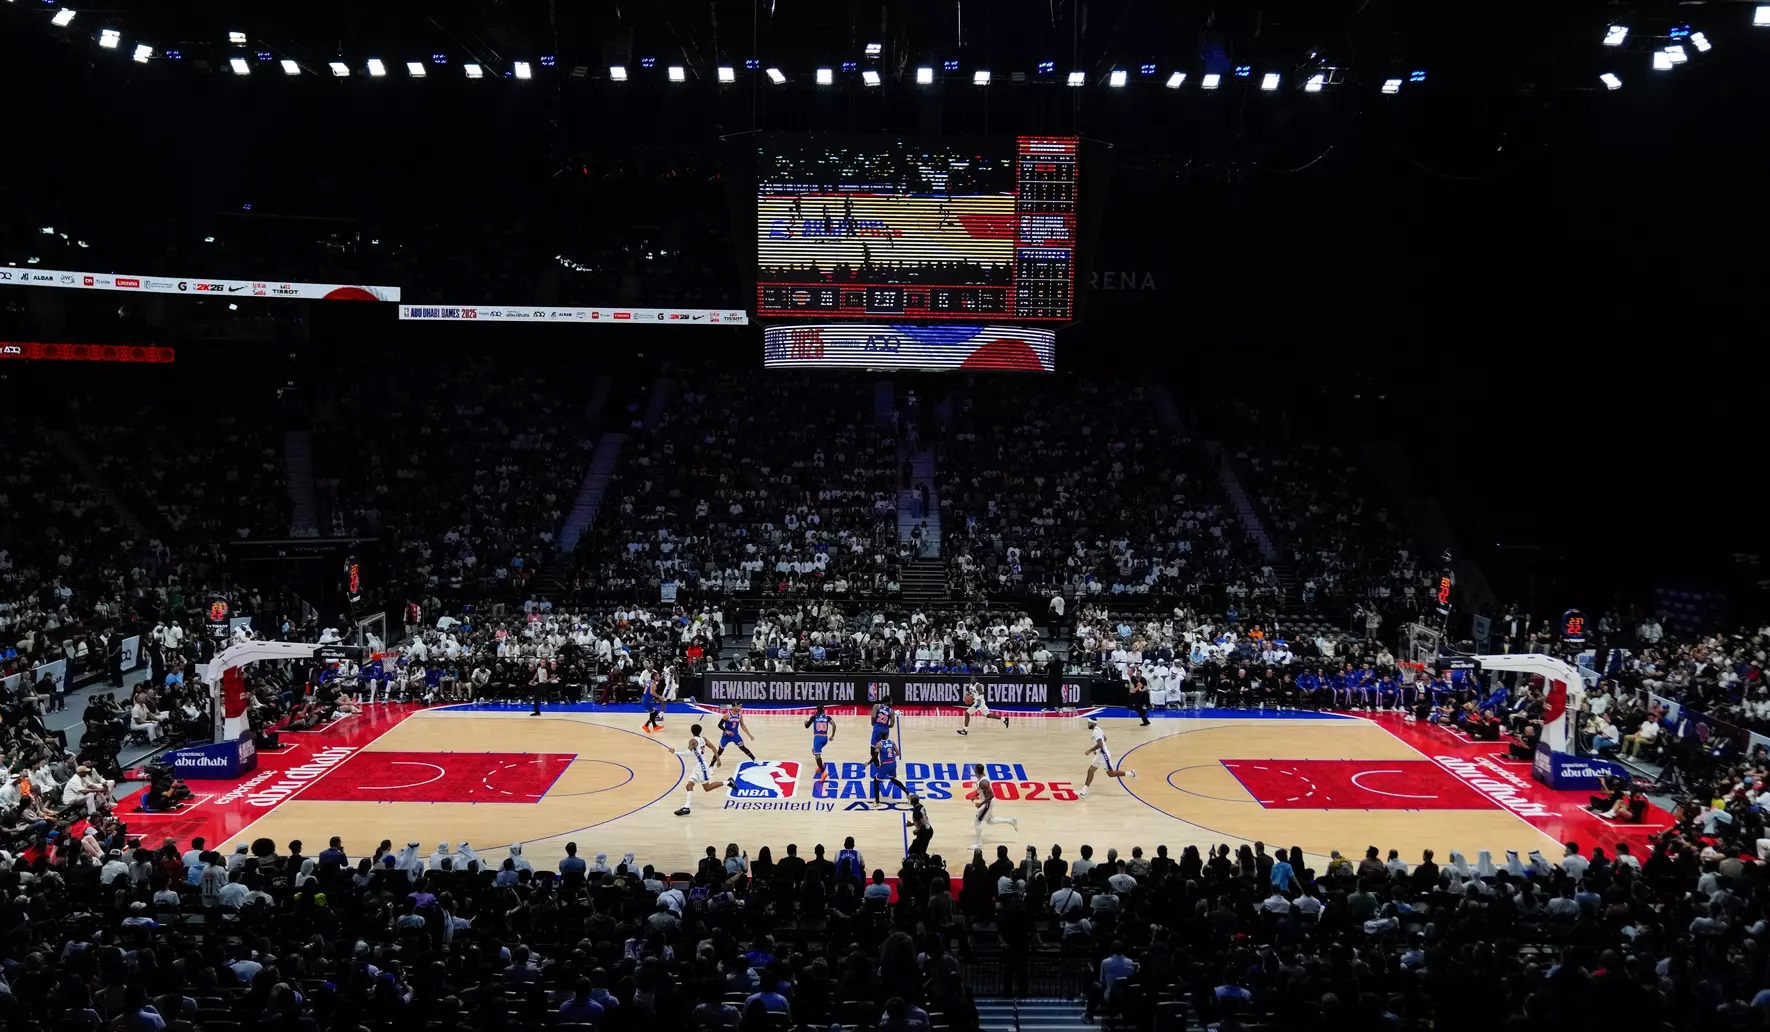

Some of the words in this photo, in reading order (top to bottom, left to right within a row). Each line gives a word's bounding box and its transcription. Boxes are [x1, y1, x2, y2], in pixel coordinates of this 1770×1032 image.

[410, 308, 422, 318] ABU
[422, 308, 440, 318] DHABI
[441, 308, 460, 318] GAMES
[461, 308, 477, 319] 2025
[791, 328, 824, 360] 2025
[1567, 624, 1583, 635] 22
[711, 680, 767, 700] REWARDS
[769, 681, 792, 700] FOR
[795, 681, 831, 700] EVERY
[833, 682, 855, 701] FAN
[904, 683, 960, 702] REWARDS
[987, 683, 1023, 702] EVERY
[1025, 684, 1048, 703] FAN
[887, 747, 893, 758] 2
[174, 757, 196, 767] abu
[197, 756, 228, 767] dhabi
[1560, 767, 1581, 777] abu
[737, 789, 770, 797] NBA
[962, 781, 1079, 801] 2025
[723, 800, 811, 811] Presented
[815, 800, 835, 812] by
